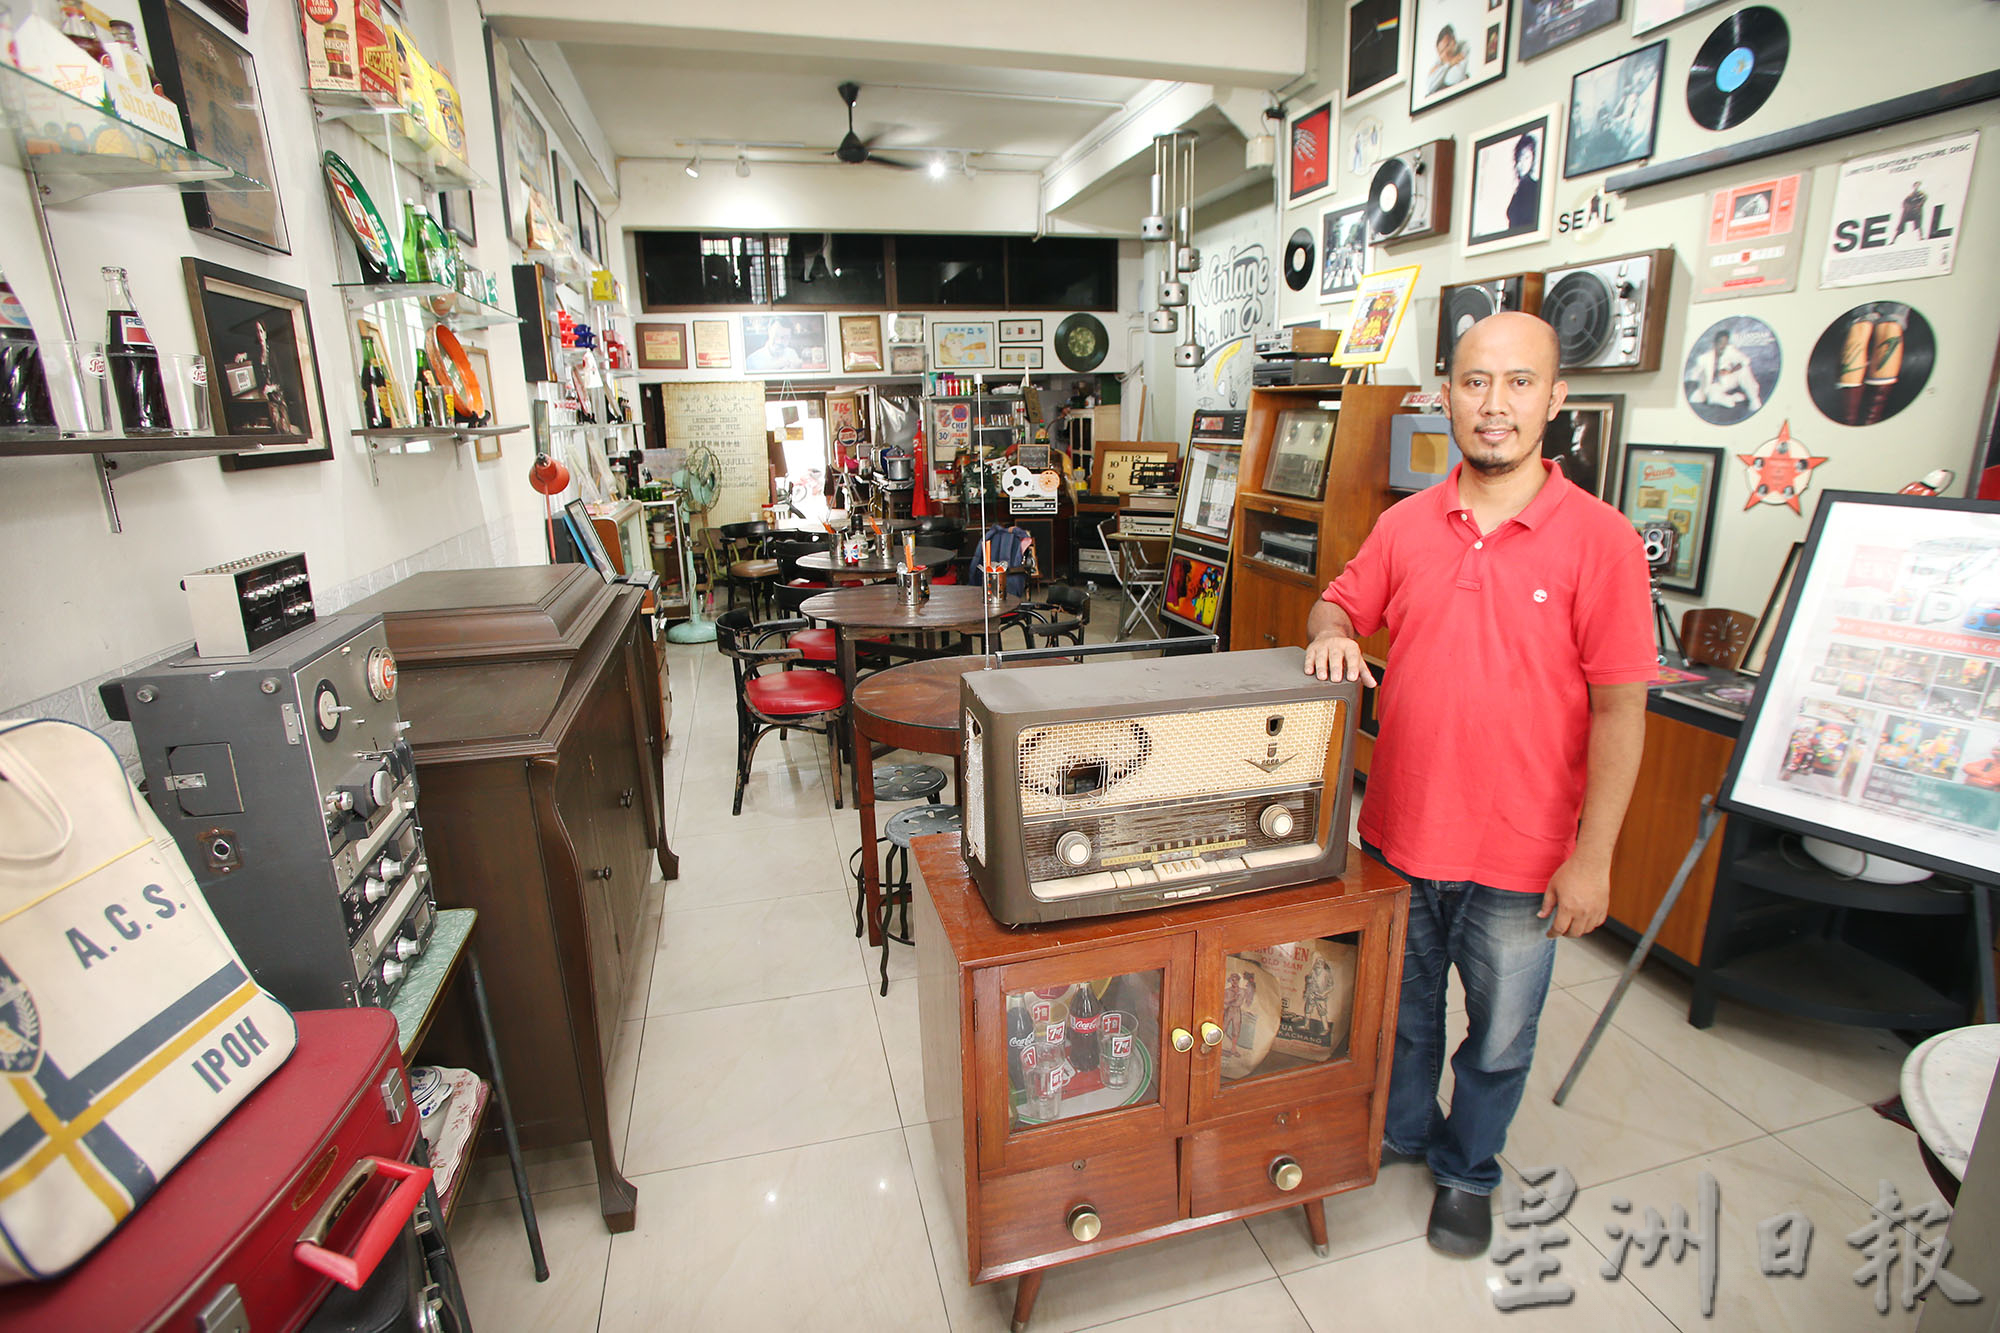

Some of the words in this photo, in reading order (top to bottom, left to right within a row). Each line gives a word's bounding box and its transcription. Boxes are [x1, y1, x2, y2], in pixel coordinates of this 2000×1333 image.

[309, 6, 333, 15] HARUM
[117, 82, 179, 133] Sinalco
[1911, 148, 1947, 161] PICTURE
[1949, 143, 1971, 155] DISC
[1197, 243, 1270, 333] Vintage
[1110, 460, 1120, 469] 10
[1107, 472, 1115, 480] 9
[1106, 484, 1114, 492] 8
[64, 883, 187, 970] A.C.S.
[191, 1015, 270, 1094] IPOH
